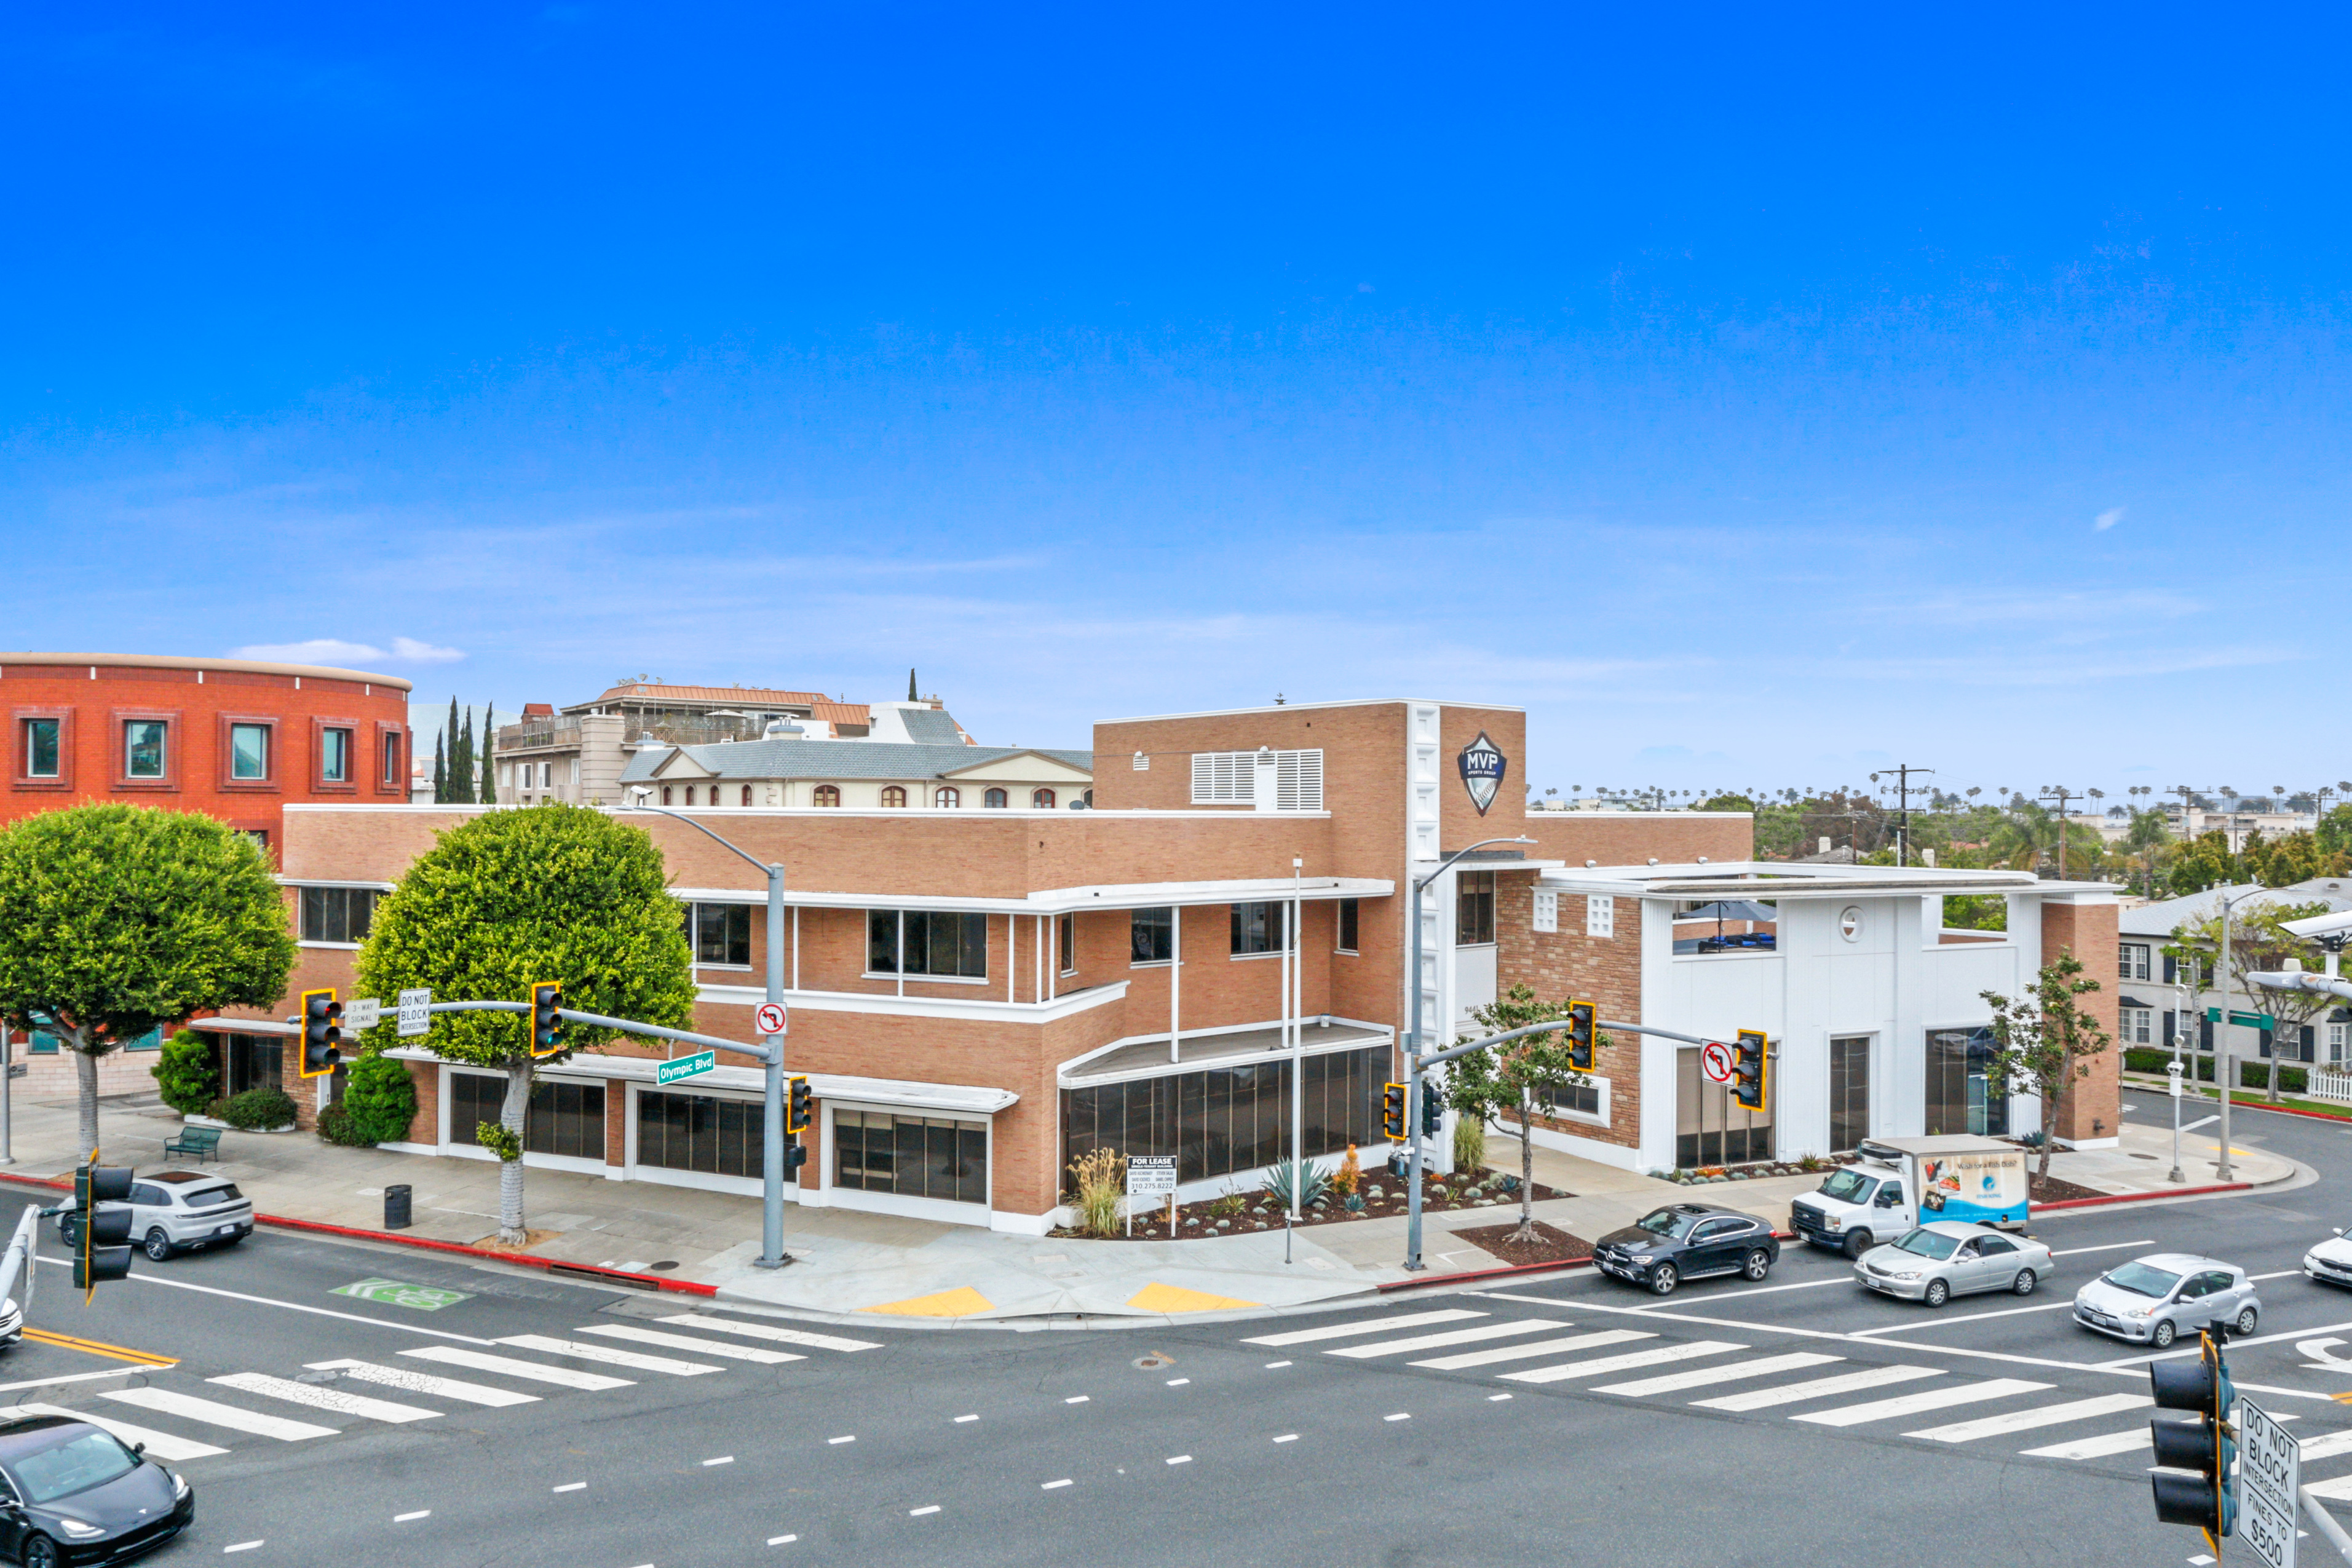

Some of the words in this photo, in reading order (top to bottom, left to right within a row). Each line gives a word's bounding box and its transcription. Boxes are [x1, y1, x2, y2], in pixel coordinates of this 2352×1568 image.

[1467, 753, 1498, 769] MVP
[402, 996, 412, 1006] DO
[414, 994, 428, 1005] NOT
[351, 1015, 372, 1023] SIGNAL
[401, 1021, 427, 1030] INTERSECTION
[402, 1008, 427, 1021] BLOCK
[660, 1062, 693, 1079] Olympic
[695, 1056, 712, 1070] Blvd
[2247, 1407, 2263, 1437] DO
[2270, 1426, 2293, 1464] NOT
[2249, 1437, 2289, 1492] BLOCK
[2244, 1460, 2294, 1518] INTERSECTION
[2248, 1492, 2273, 1526] FINES
[2277, 1521, 2287, 1541] TO
[2251, 1518, 2282, 1566] $500
